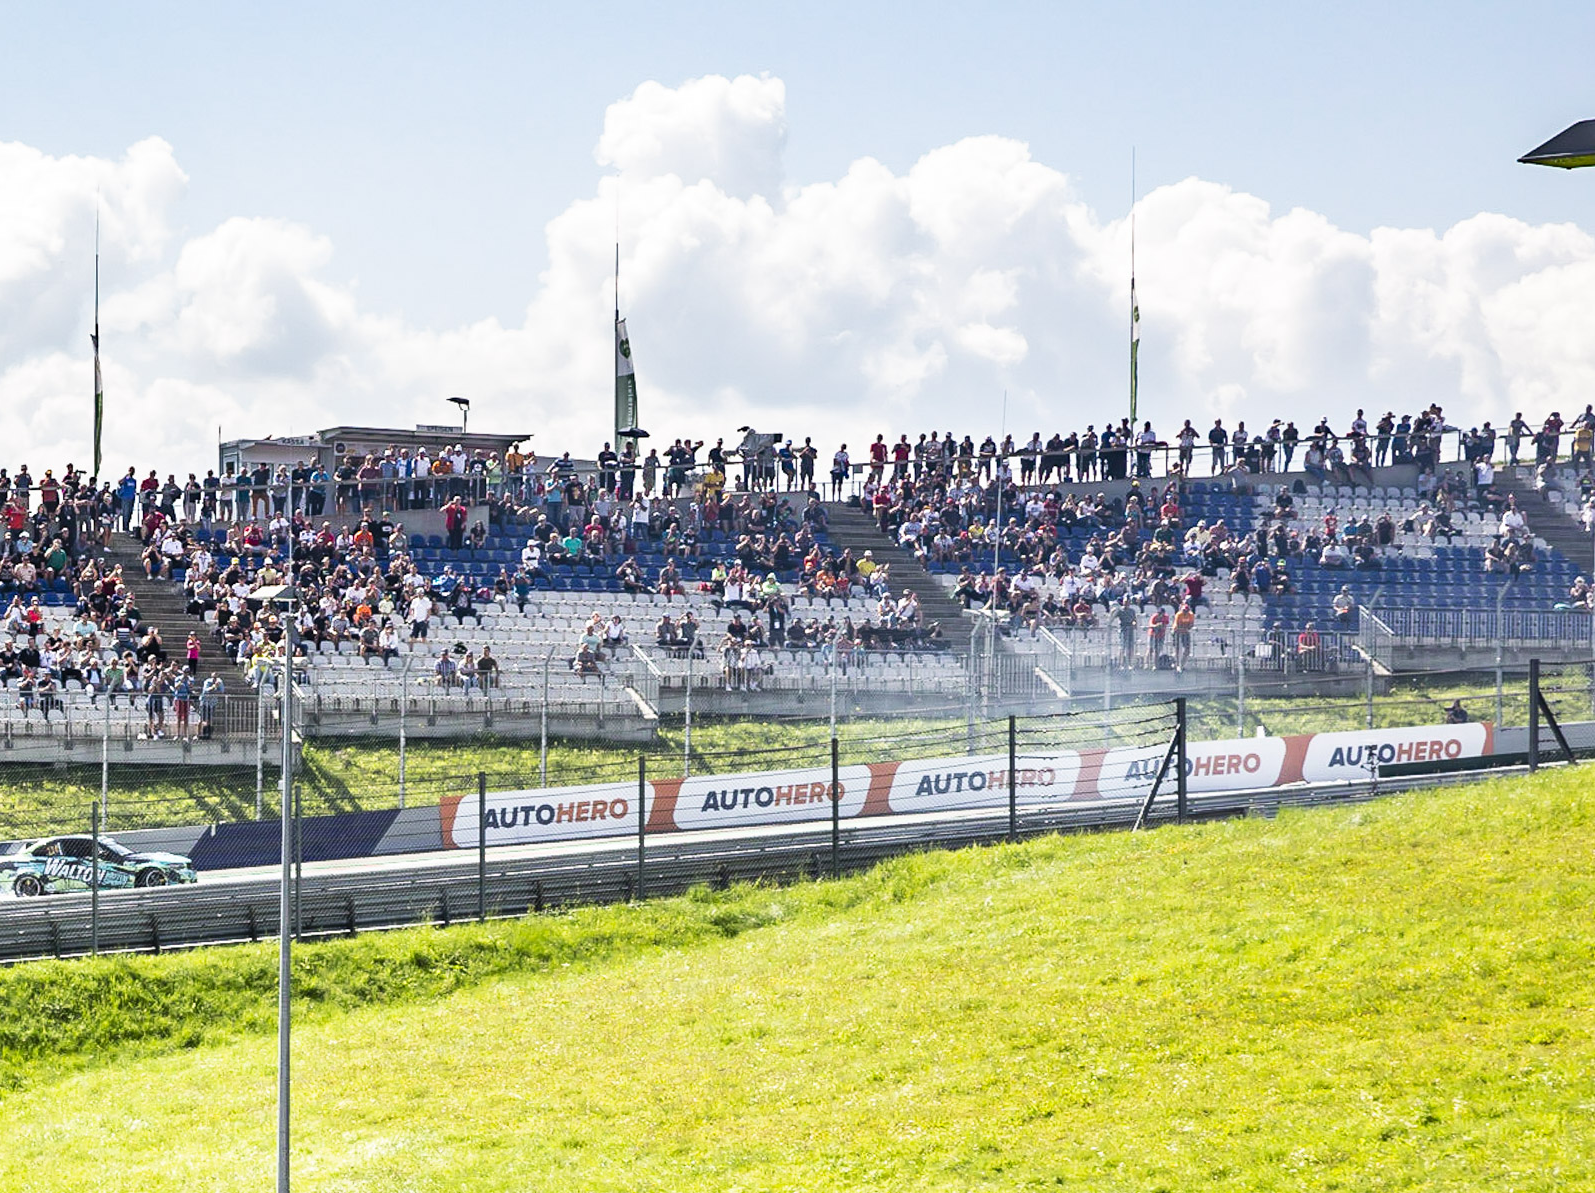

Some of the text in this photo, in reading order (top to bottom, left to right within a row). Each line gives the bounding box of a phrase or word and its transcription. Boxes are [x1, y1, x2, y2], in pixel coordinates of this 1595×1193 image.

[1328, 738, 1462, 767] AUTOHERO
[915, 766, 1055, 796] AUTOHERO
[701, 782, 845, 812] AUTOHERO
[482, 797, 629, 829] AUTOHERO
[43, 857, 106, 885] WALTON
